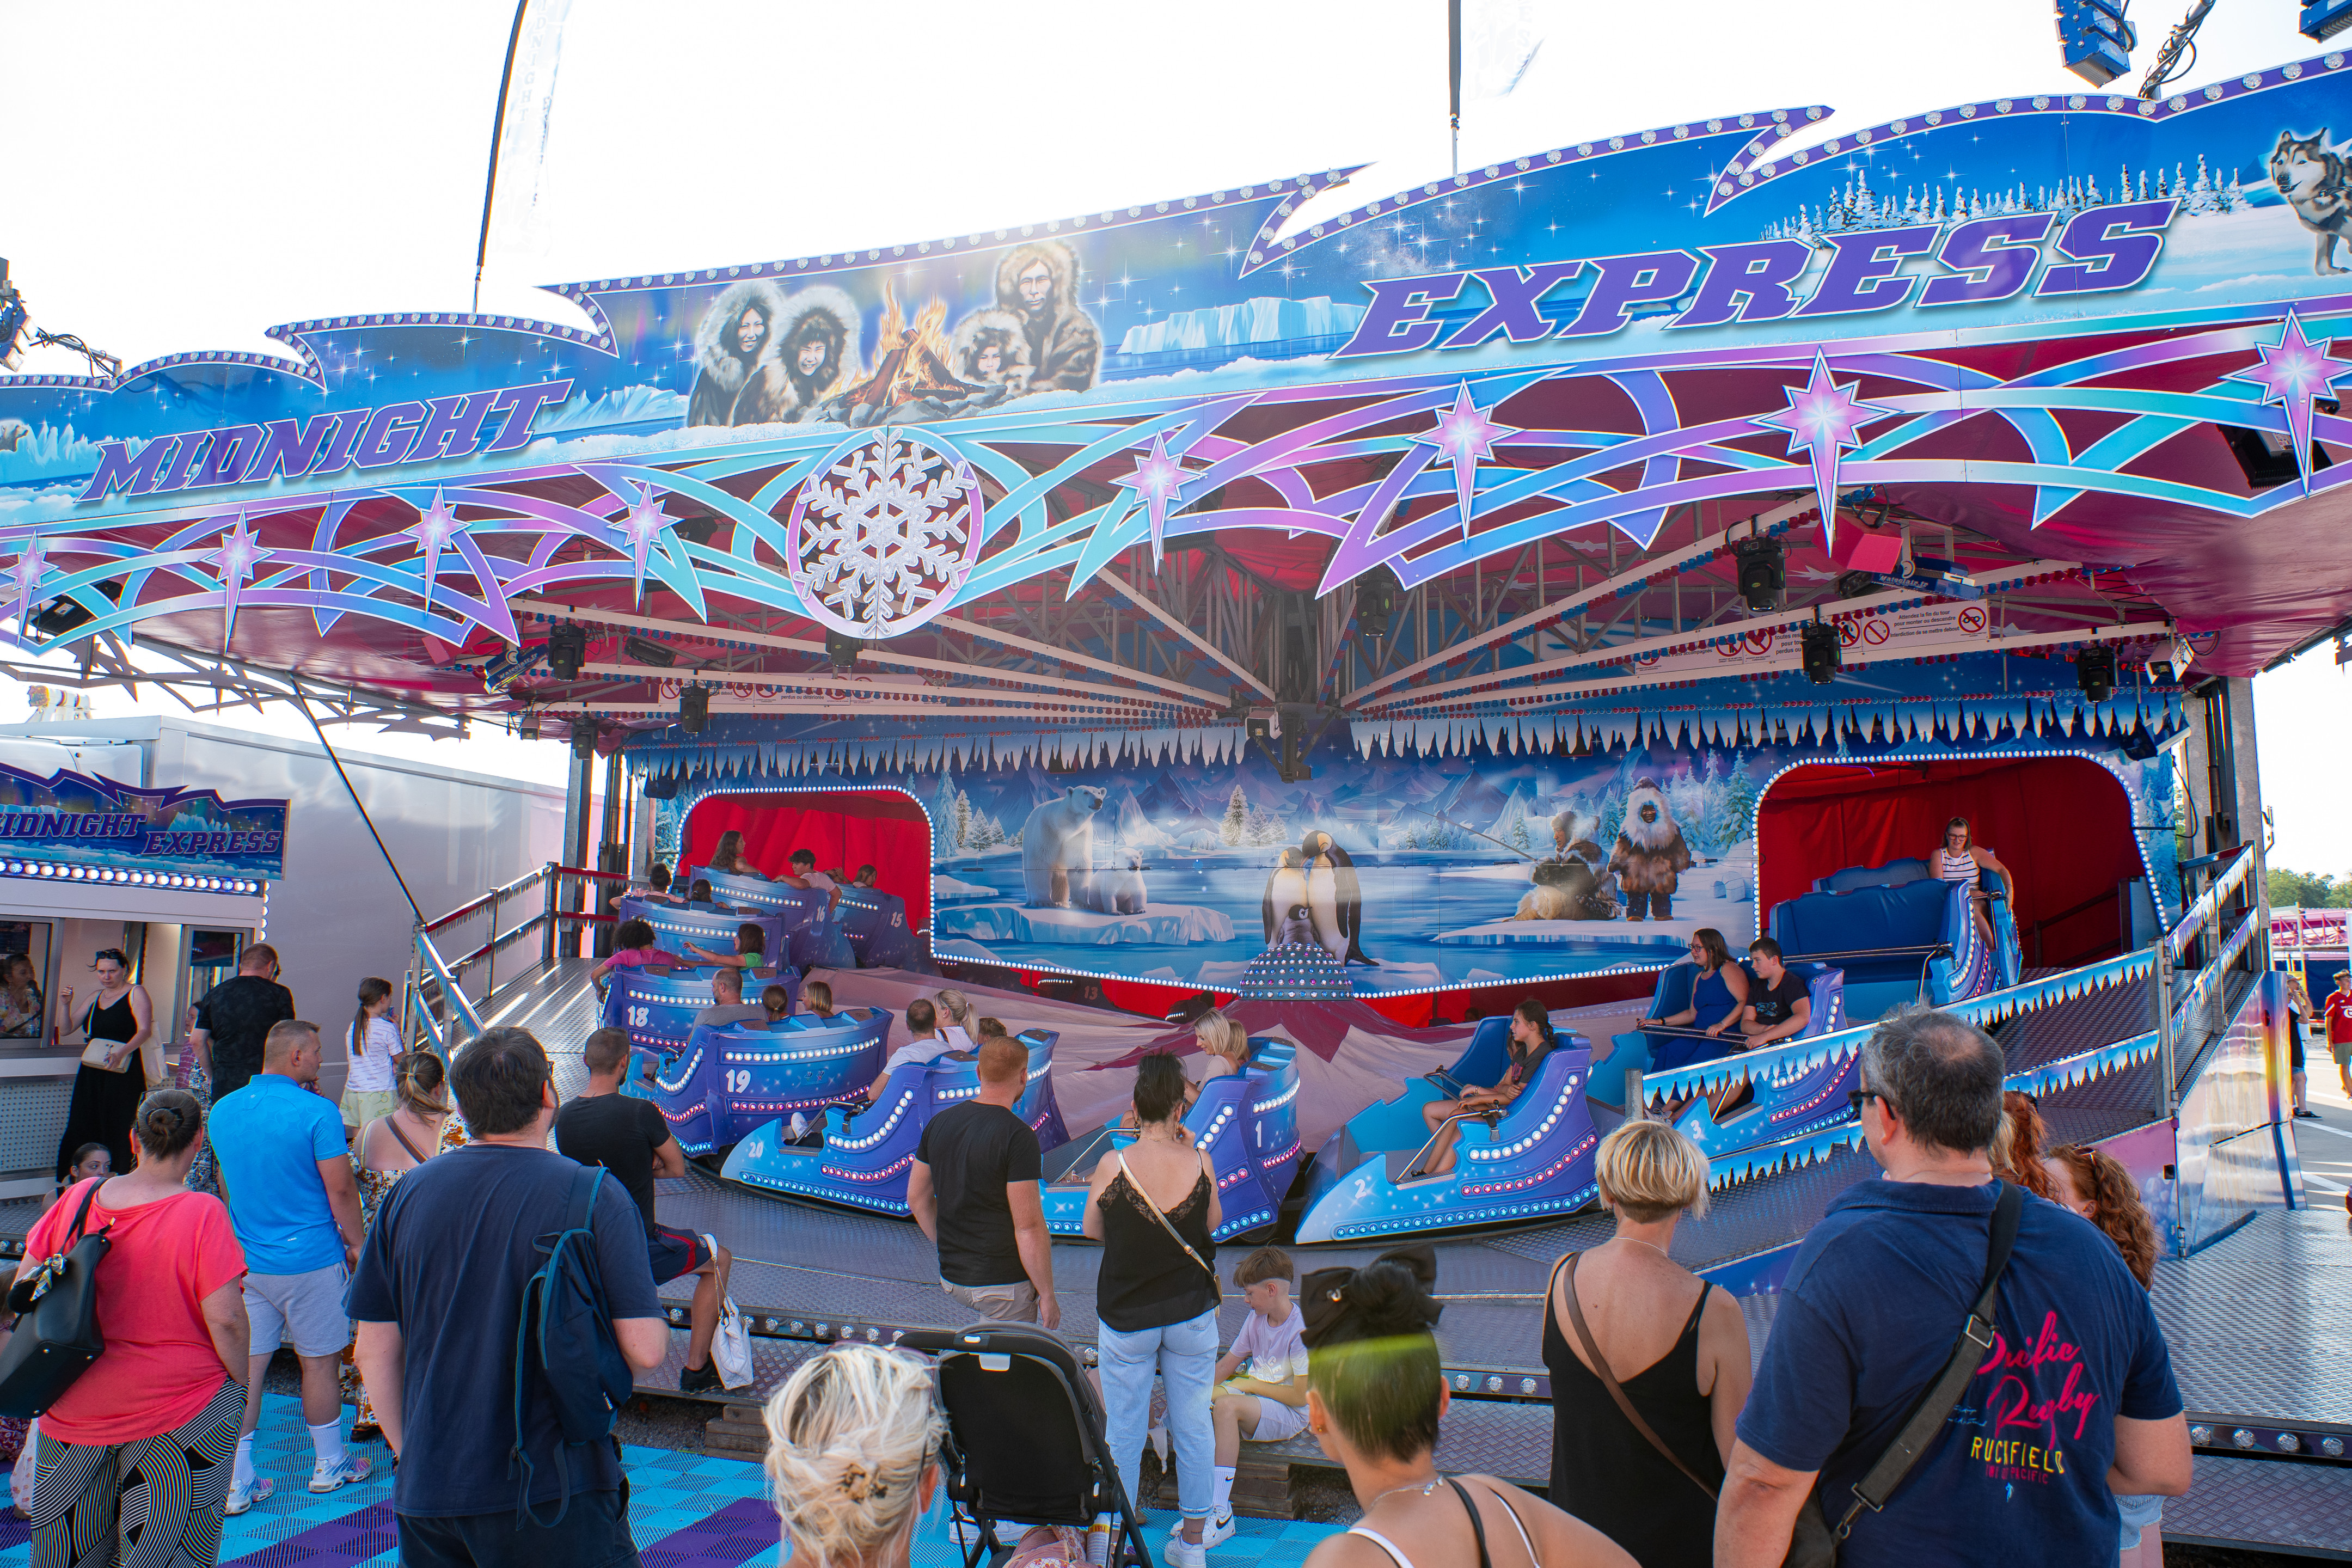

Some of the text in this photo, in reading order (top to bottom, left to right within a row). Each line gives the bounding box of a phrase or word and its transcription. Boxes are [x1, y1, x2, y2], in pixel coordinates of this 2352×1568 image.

[75, 198, 2183, 503] MIDNIGHT EXPRESS
[0, 813, 283, 855] IDNIGHT EXPRESS
[816, 905, 826, 922] 16
[891, 911, 903, 928] 15
[1085, 985, 1098, 1000] 13
[628, 1005, 650, 1027] 18
[725, 1069, 751, 1093] 19
[1255, 1120, 1262, 1148] 1
[1690, 1119, 1702, 1140] 3
[749, 1141, 764, 1158] 20
[1355, 1179, 1367, 1199] 2
[1986, 1362, 2100, 1450] Rugby
